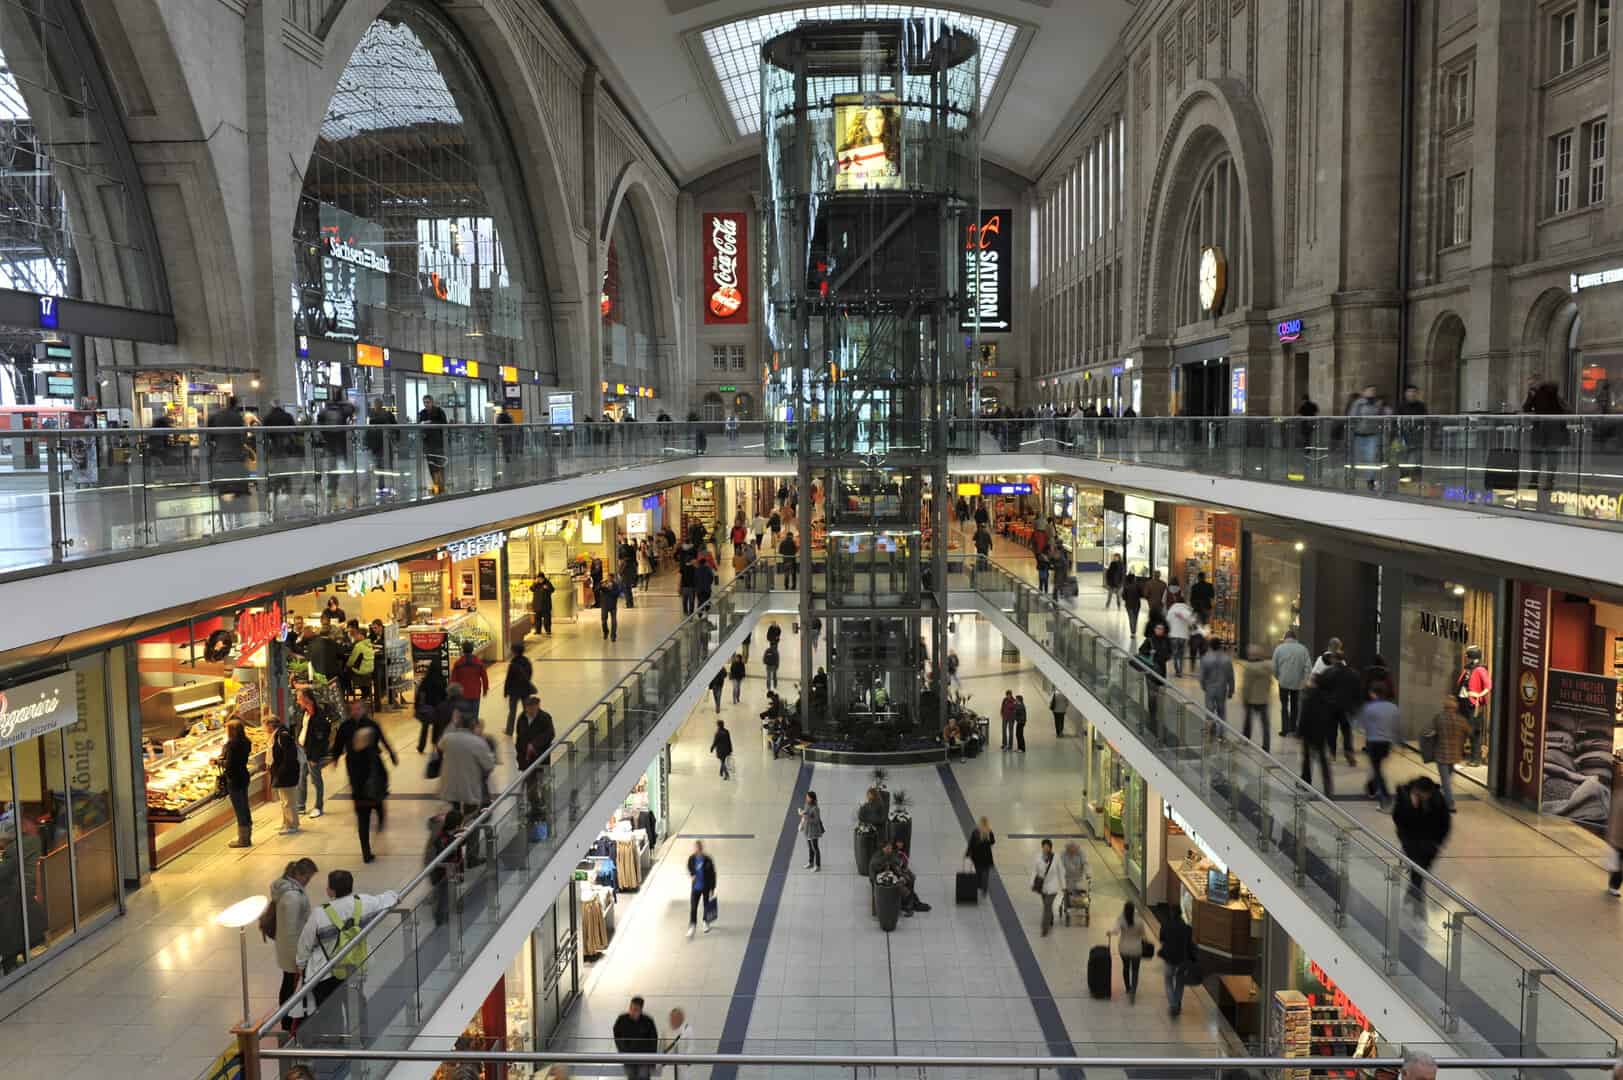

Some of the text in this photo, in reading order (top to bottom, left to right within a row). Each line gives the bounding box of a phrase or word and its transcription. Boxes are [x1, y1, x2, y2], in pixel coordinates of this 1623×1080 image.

[40, 296, 53, 315] 17
[979, 250, 999, 318] SATURN
[1278, 319, 1301, 337] COSMO
[1419, 610, 1469, 645] MANGO
[1521, 598, 1543, 669] RITAZZA
[1519, 710, 1536, 784] Caffè
